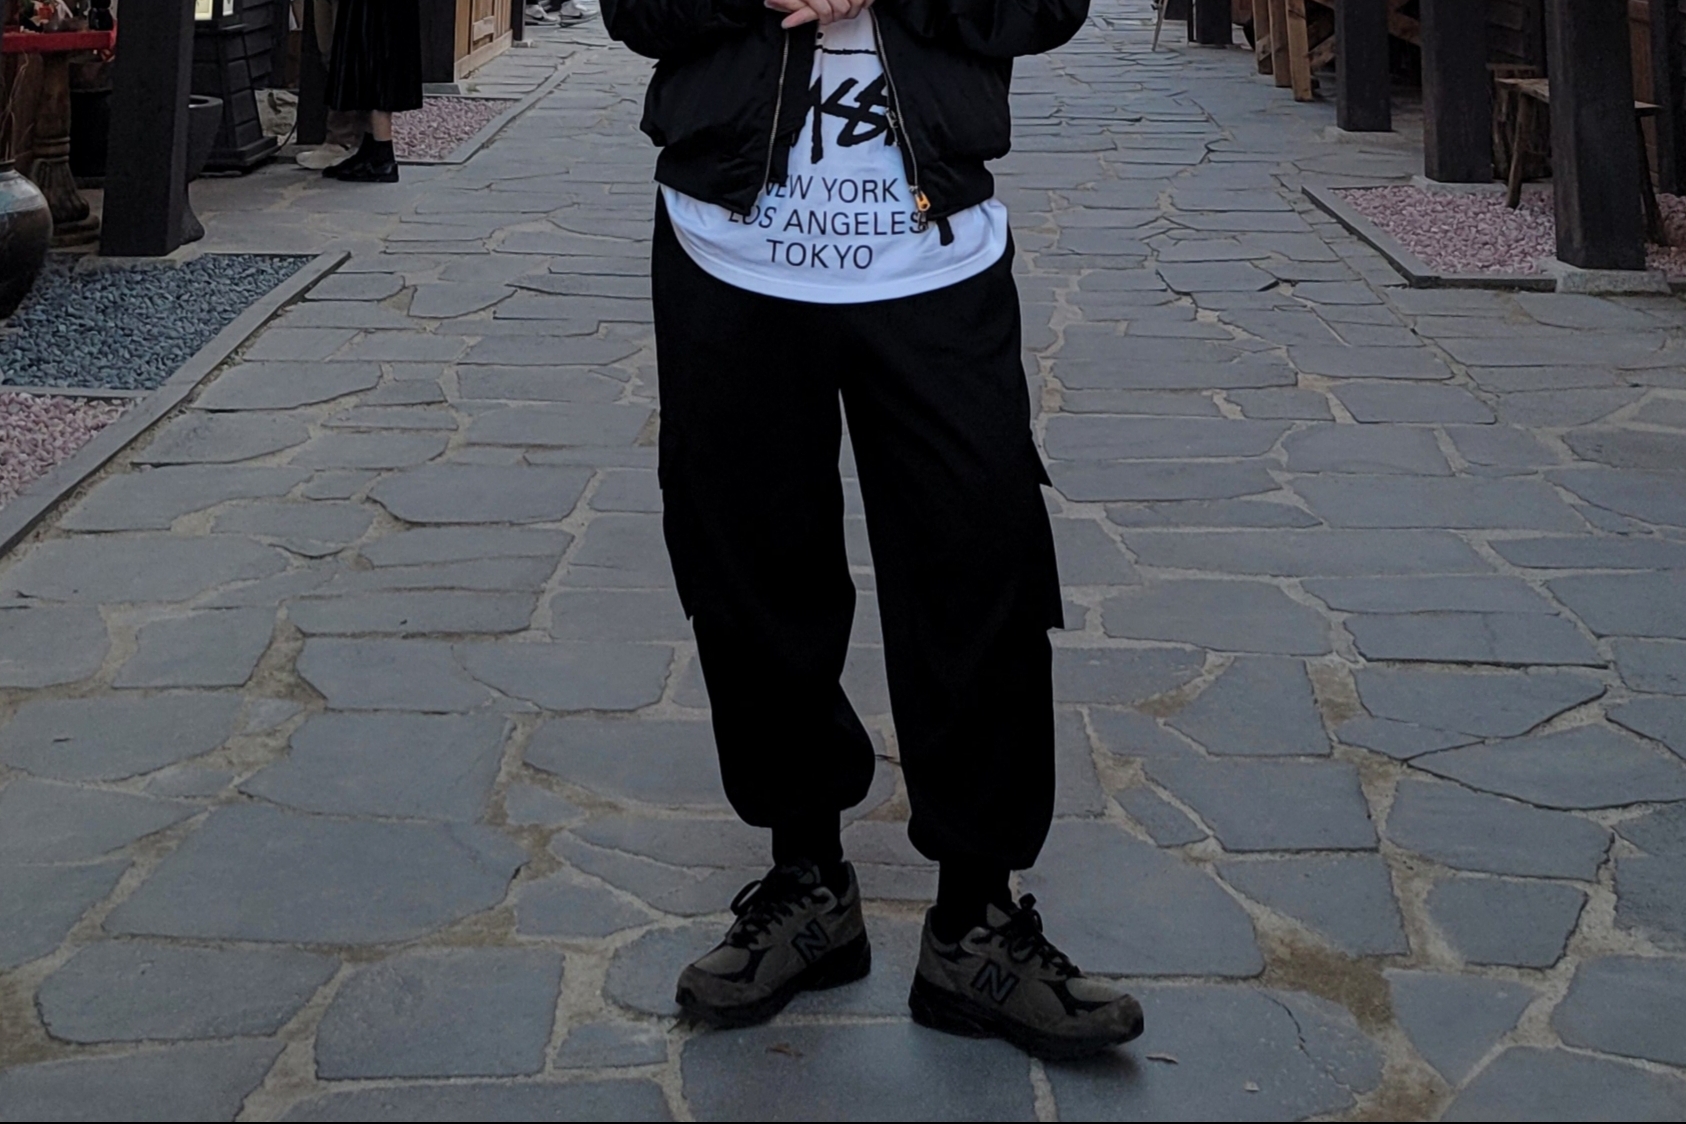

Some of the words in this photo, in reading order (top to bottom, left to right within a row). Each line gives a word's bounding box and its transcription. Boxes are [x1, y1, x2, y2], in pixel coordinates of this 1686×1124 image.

[821, 178, 901, 204] YORK
[783, 209, 926, 236] ANGELES
[765, 238, 874, 270] TOKYO
[790, 919, 831, 965] N
[970, 957, 1020, 1003] N
